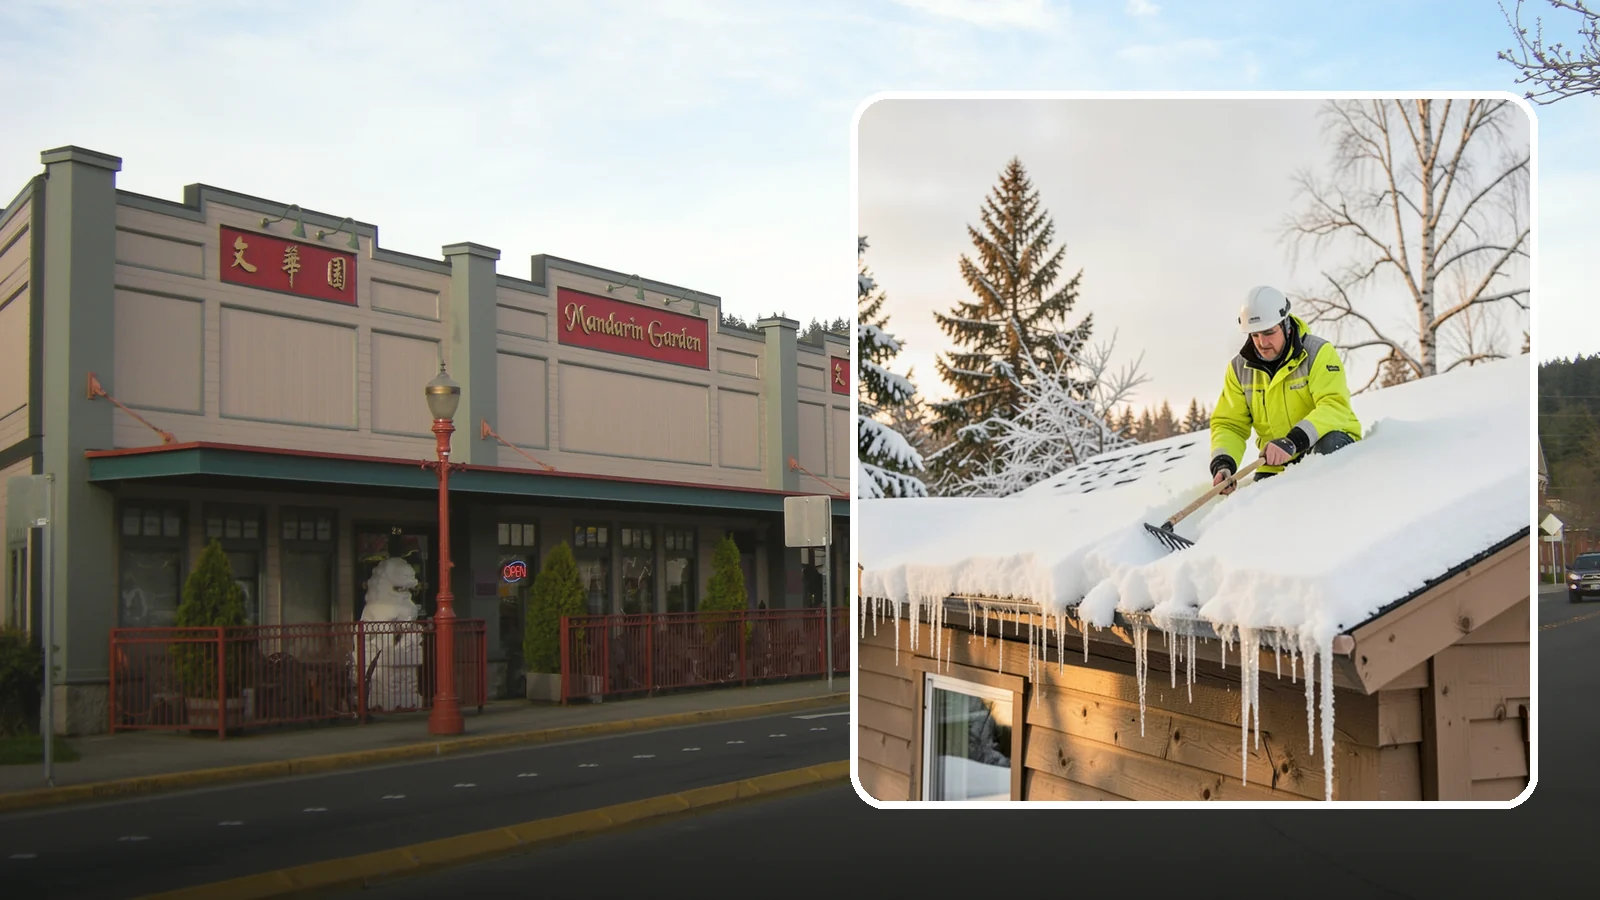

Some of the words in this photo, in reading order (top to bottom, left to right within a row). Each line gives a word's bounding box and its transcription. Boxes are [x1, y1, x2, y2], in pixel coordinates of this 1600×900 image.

[231, 236, 346, 291] 文華園
[564, 302, 644, 341] Mandarin
[648, 320, 702, 352] Garden
[503, 565, 527, 578] OPEN
